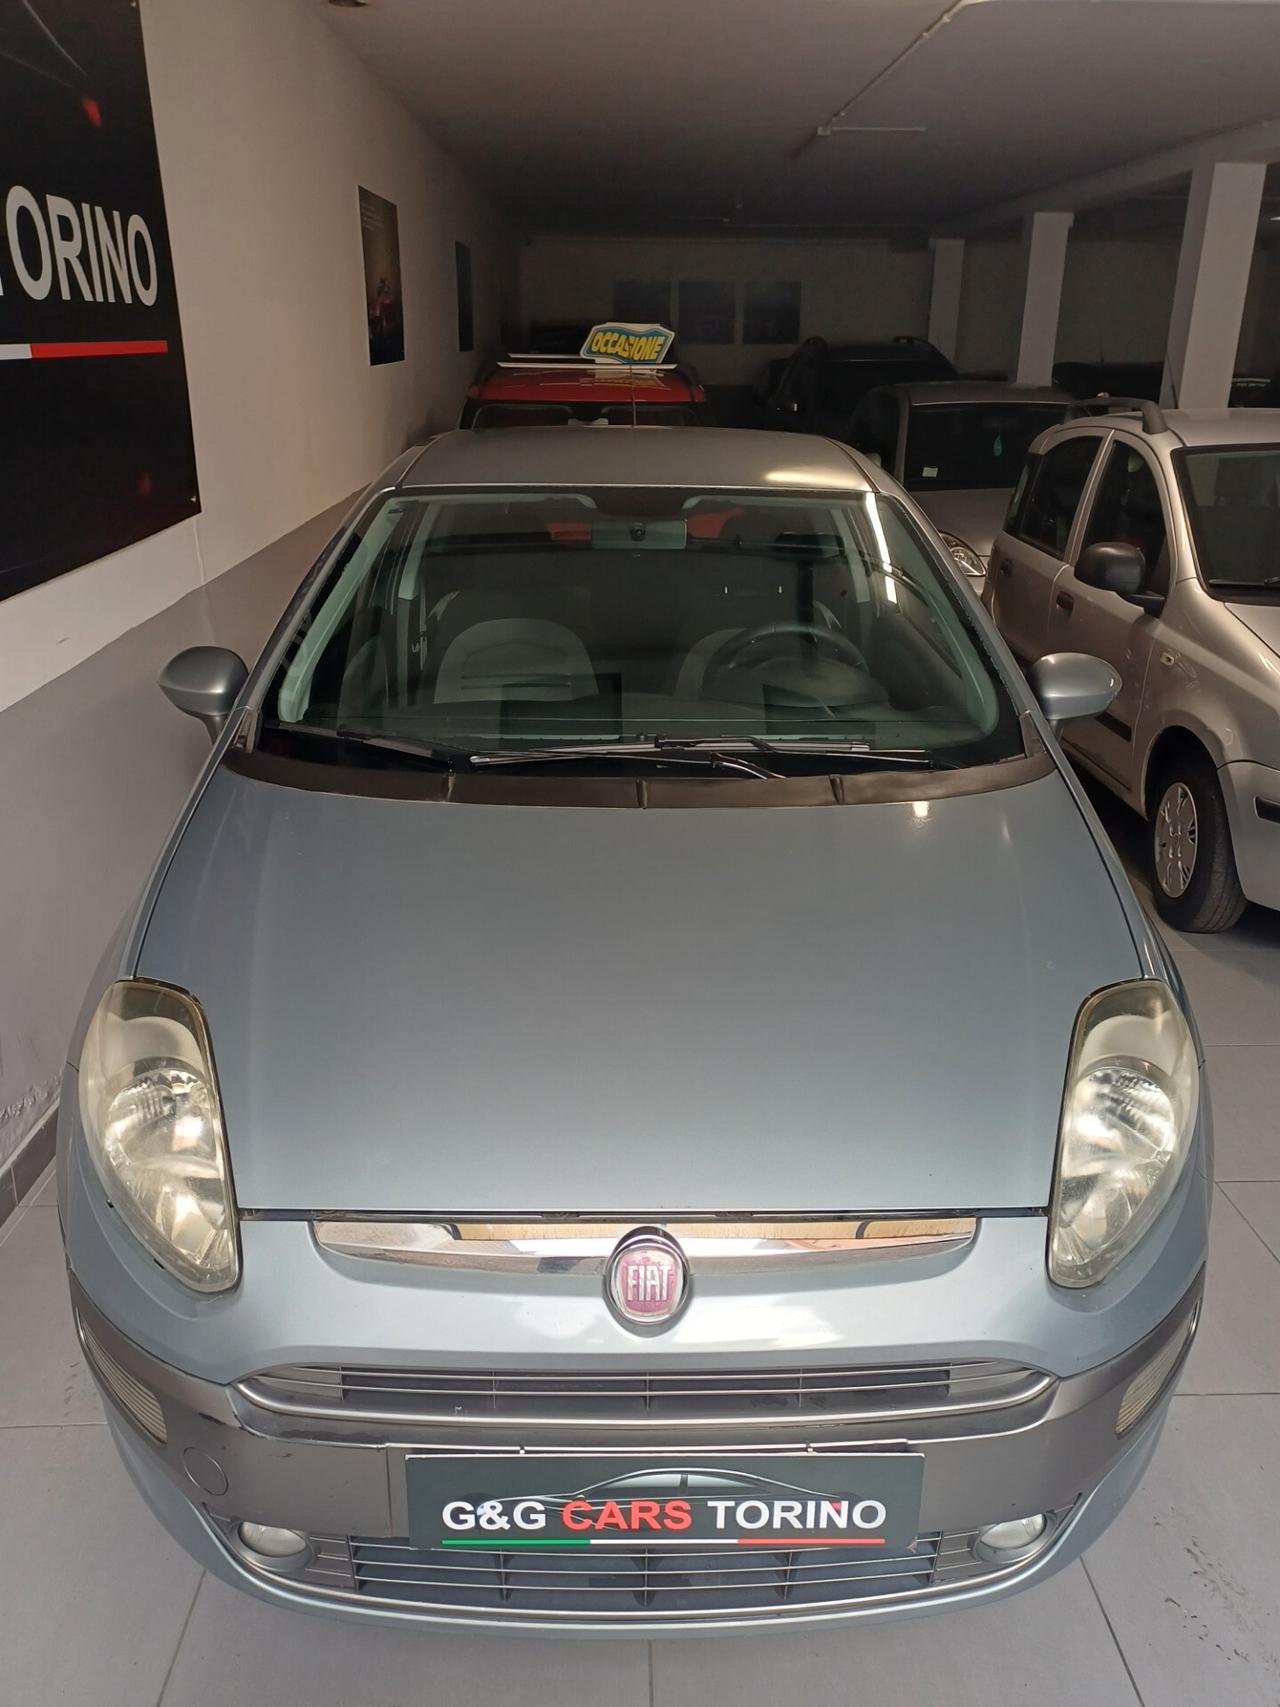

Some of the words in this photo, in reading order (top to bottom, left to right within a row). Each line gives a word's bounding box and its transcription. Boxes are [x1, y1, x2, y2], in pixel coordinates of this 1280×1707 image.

[0, 185, 158, 306] ORINO
[591, 331, 665, 360] OCCASIONE
[627, 1265, 671, 1301] FIAT
[442, 1501, 547, 1530] G&G
[562, 1500, 692, 1530] CARS
[707, 1500, 886, 1529] TORINO
